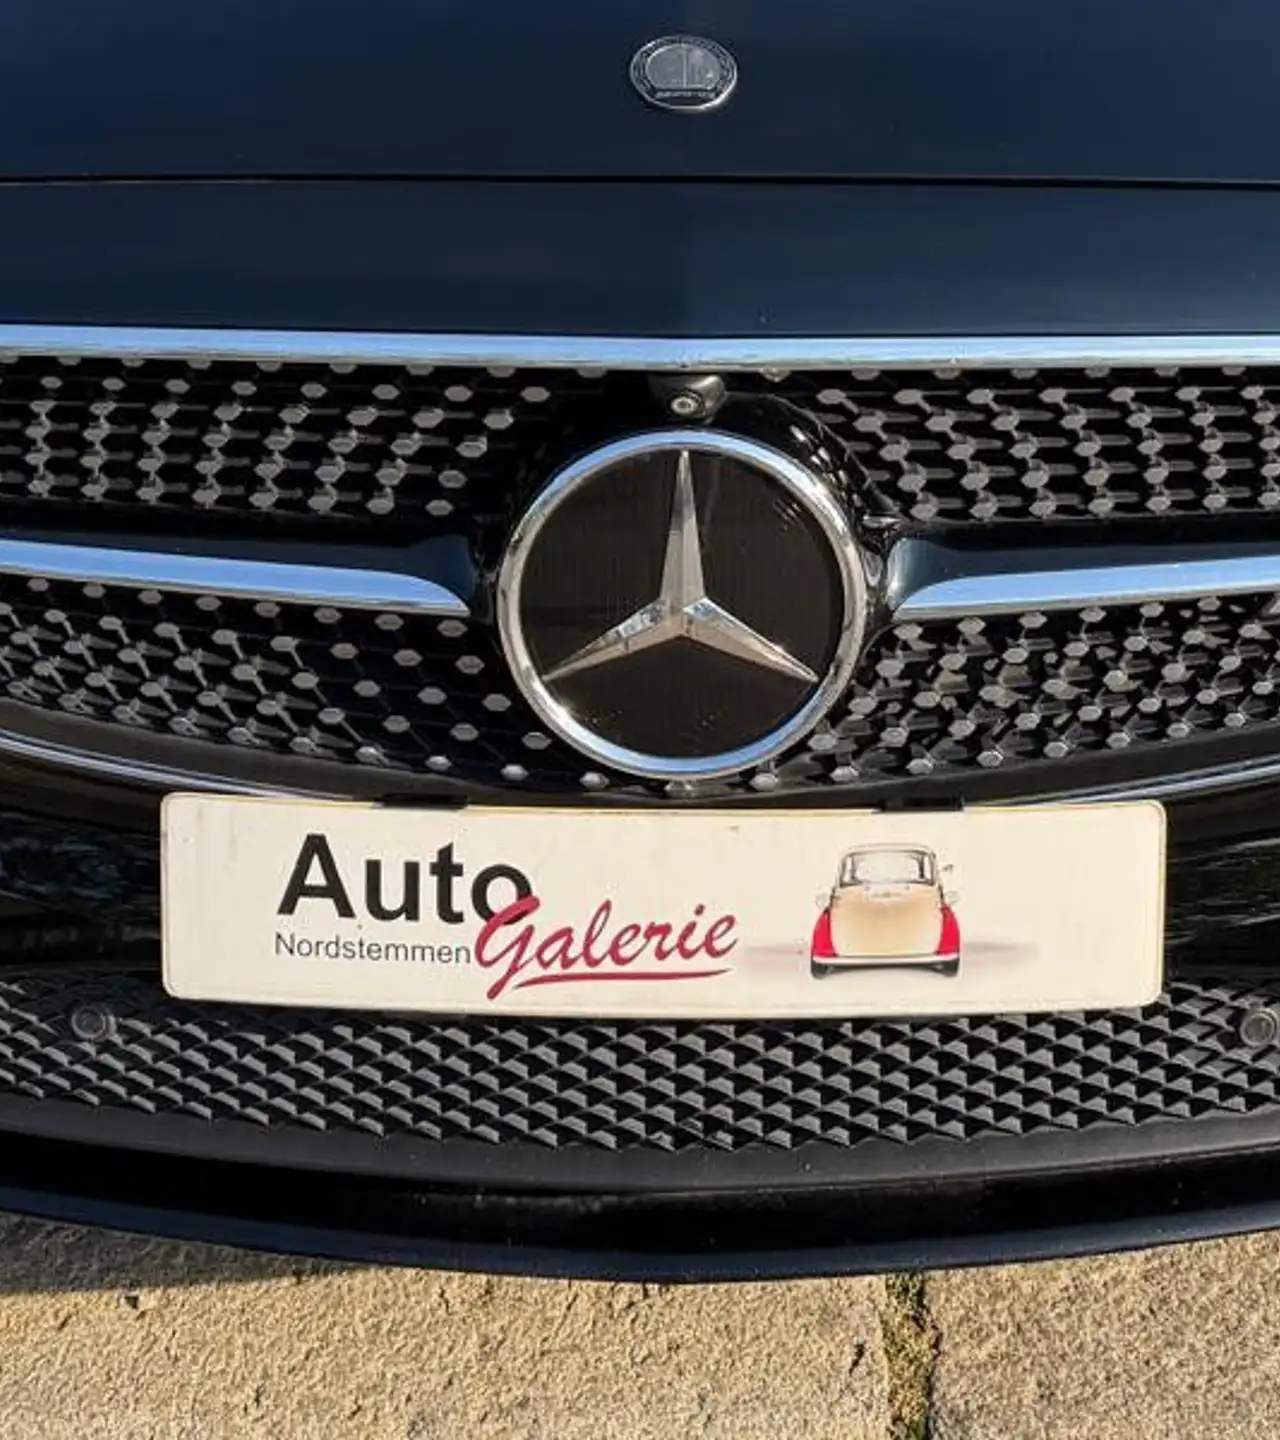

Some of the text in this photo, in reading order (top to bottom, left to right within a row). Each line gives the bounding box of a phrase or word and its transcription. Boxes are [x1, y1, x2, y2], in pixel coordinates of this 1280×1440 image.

[276, 833, 537, 928] Auto
[273, 892, 740, 1001] Nordstemmen Galerie
